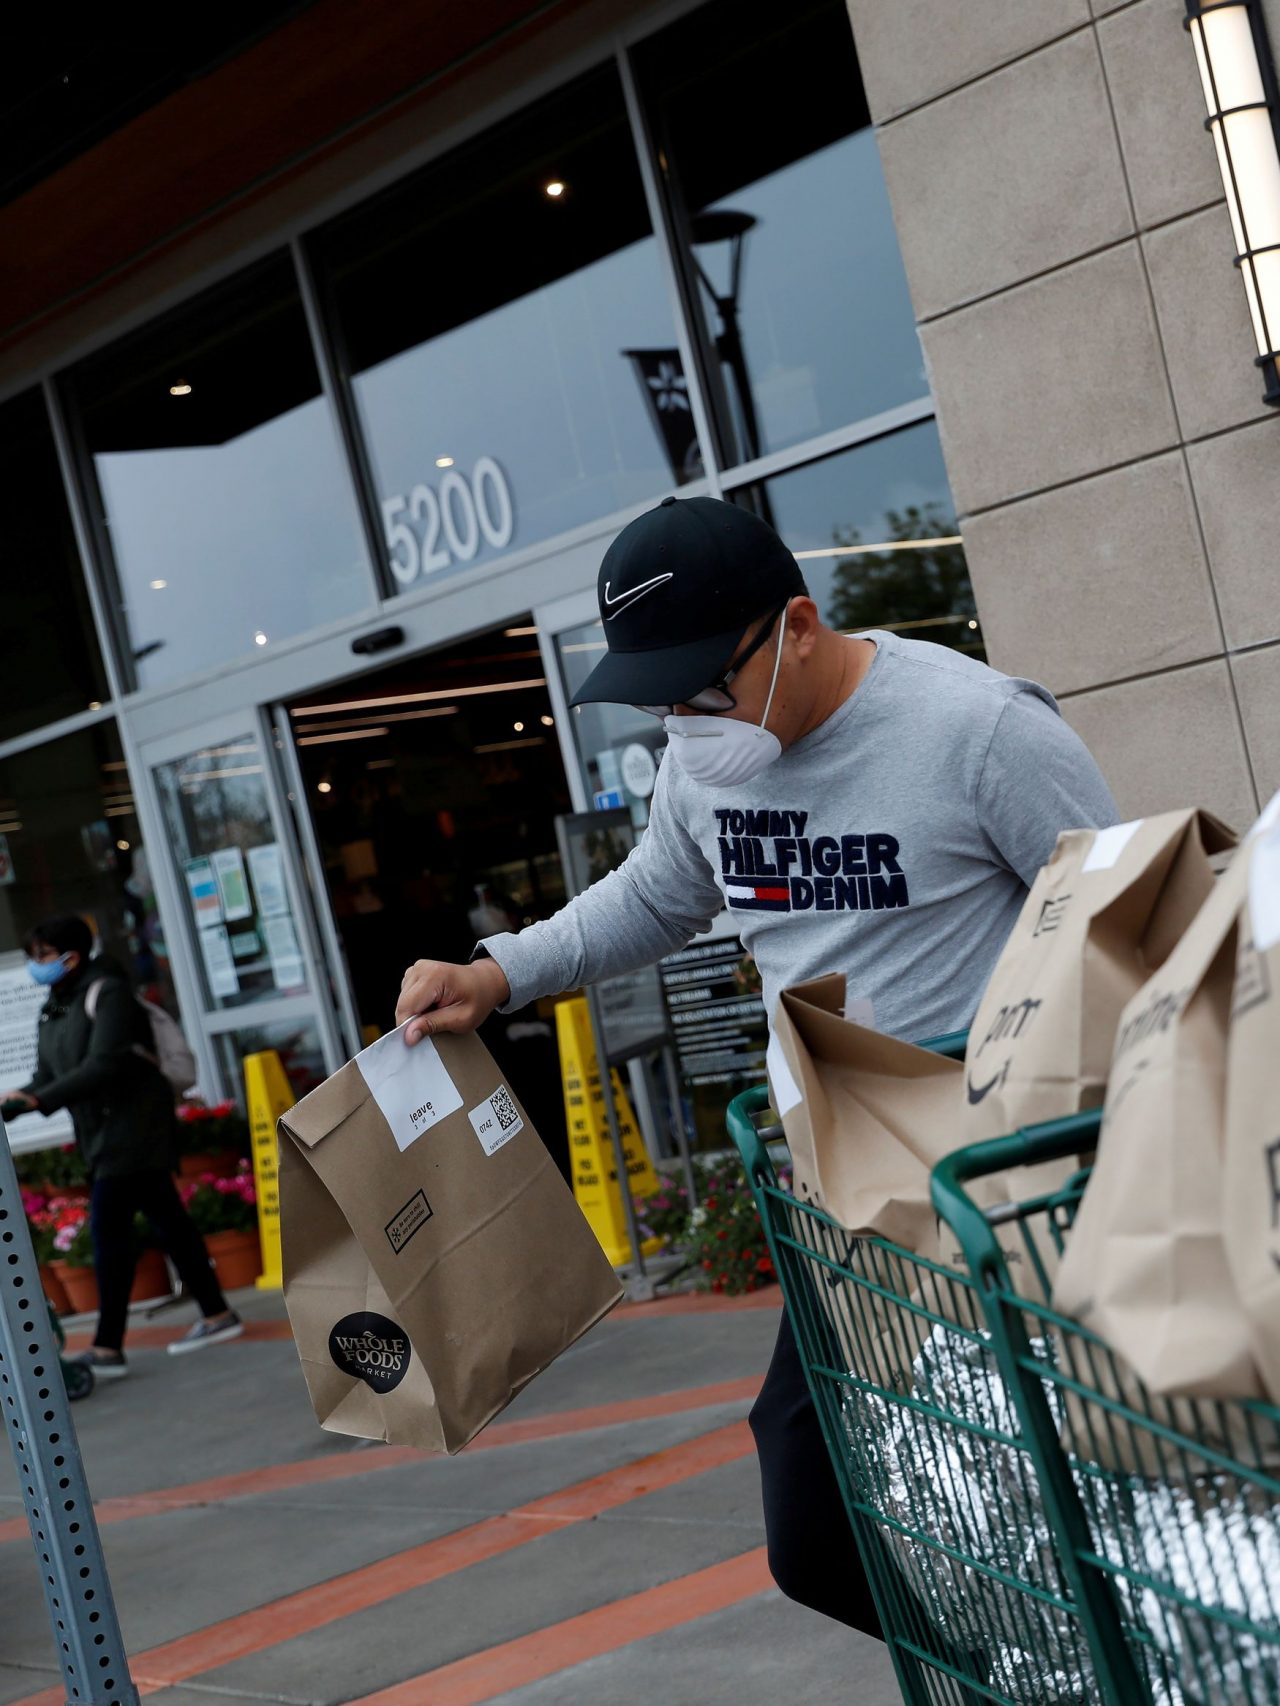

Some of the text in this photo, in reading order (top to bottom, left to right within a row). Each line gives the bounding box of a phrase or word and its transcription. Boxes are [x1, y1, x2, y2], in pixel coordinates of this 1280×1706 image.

[382, 457, 513, 584] 5200
[714, 808, 809, 837] TOMMY
[717, 833, 904, 876] HILFIGER
[790, 873, 910, 910] DENIM
[409, 1101, 433, 1124] leave
[335, 1331, 405, 1354] WHOLE
[342, 1349, 403, 1371] FOODS
